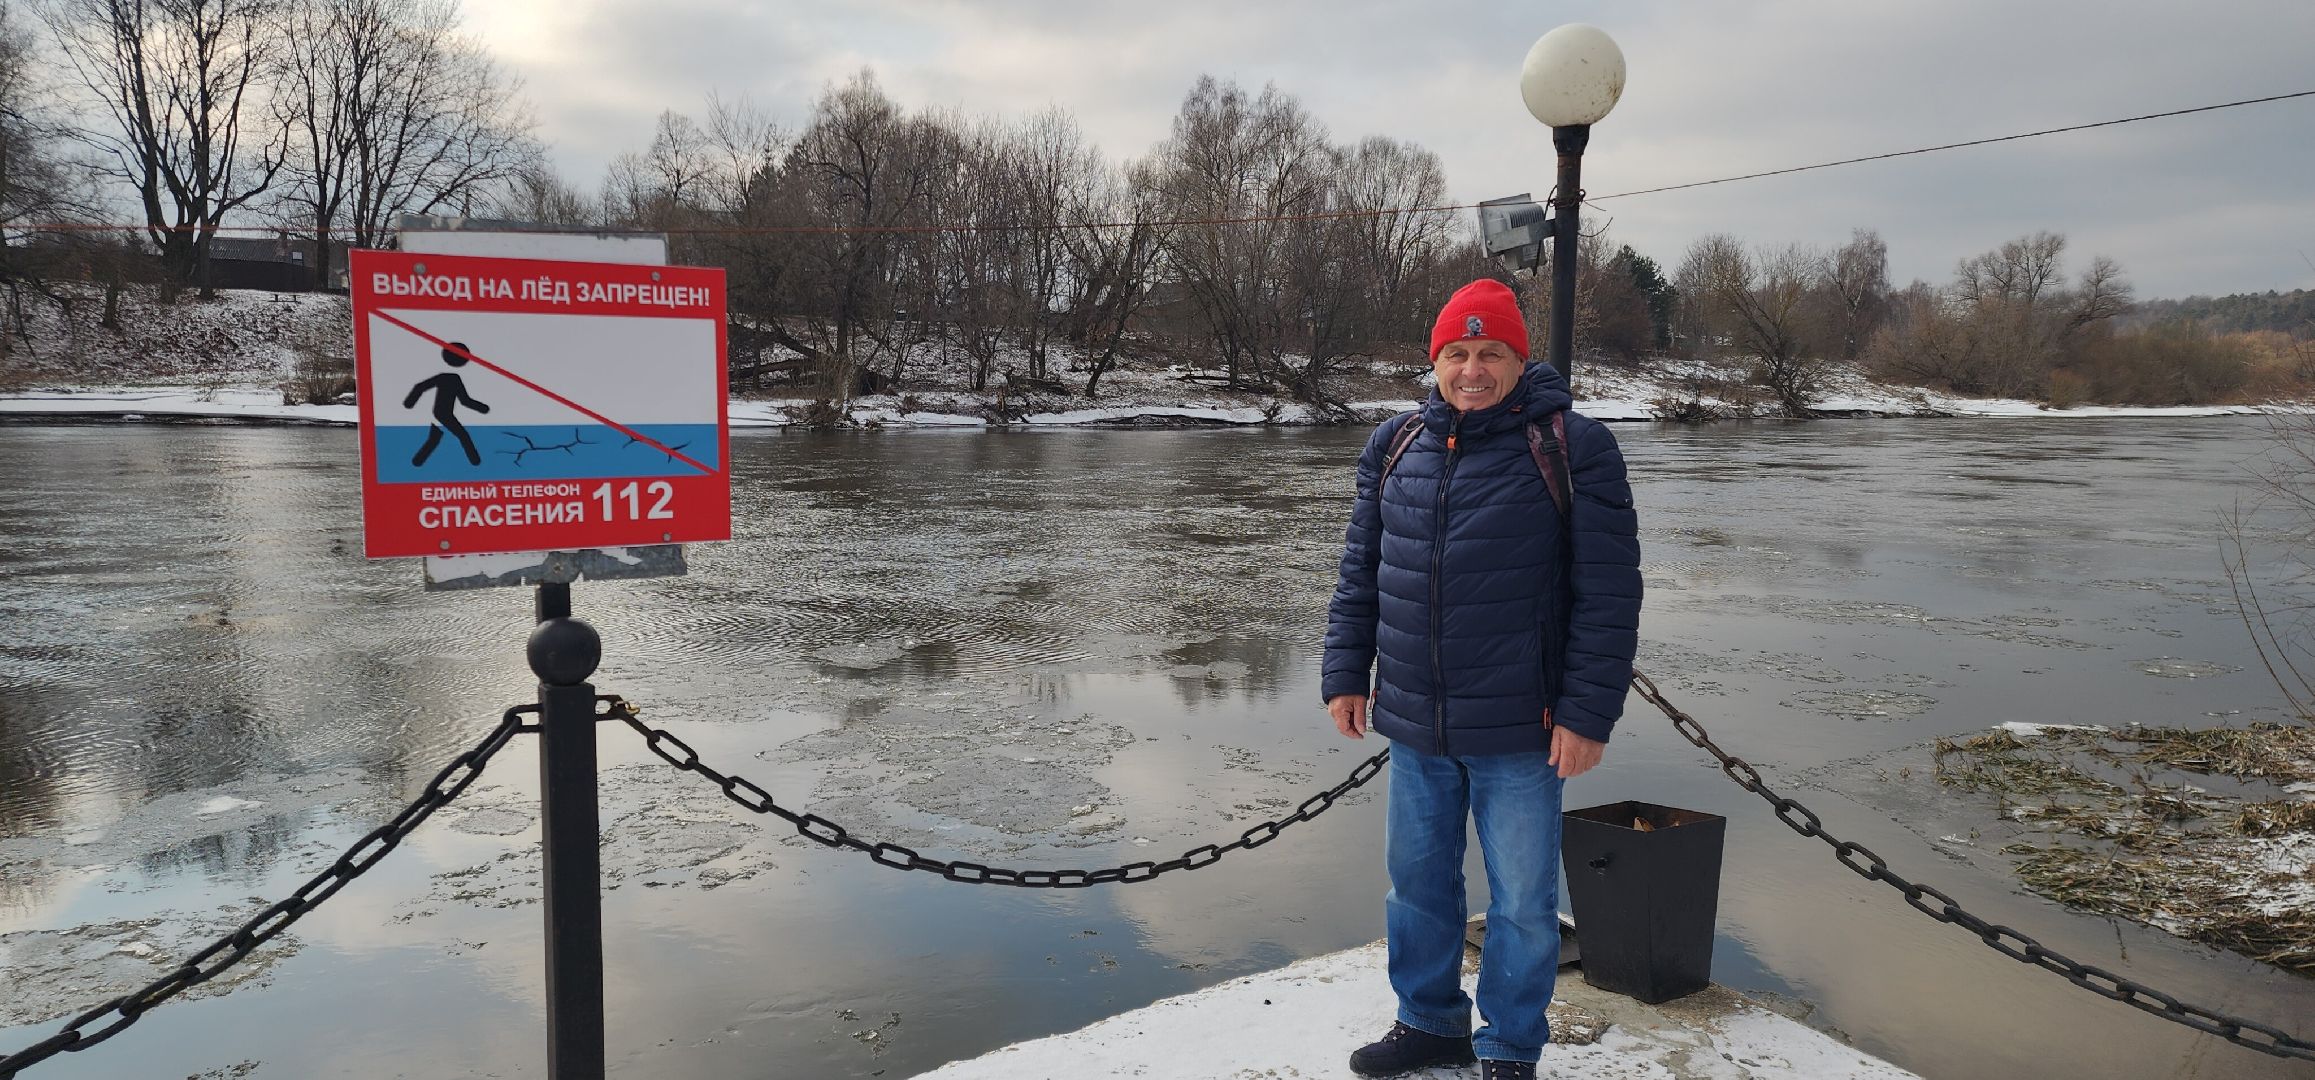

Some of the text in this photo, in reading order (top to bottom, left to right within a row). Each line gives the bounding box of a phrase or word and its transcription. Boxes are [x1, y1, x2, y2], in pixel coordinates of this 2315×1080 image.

[372, 273, 711, 309] ВЫХОД НА ЛЁД ЗАПРЕЩЕН!
[418, 480, 674, 529] СПАСЕНИЯ 112
[421, 483, 580, 503] ЕДИНЫЙ ТЕЛЕФОН
